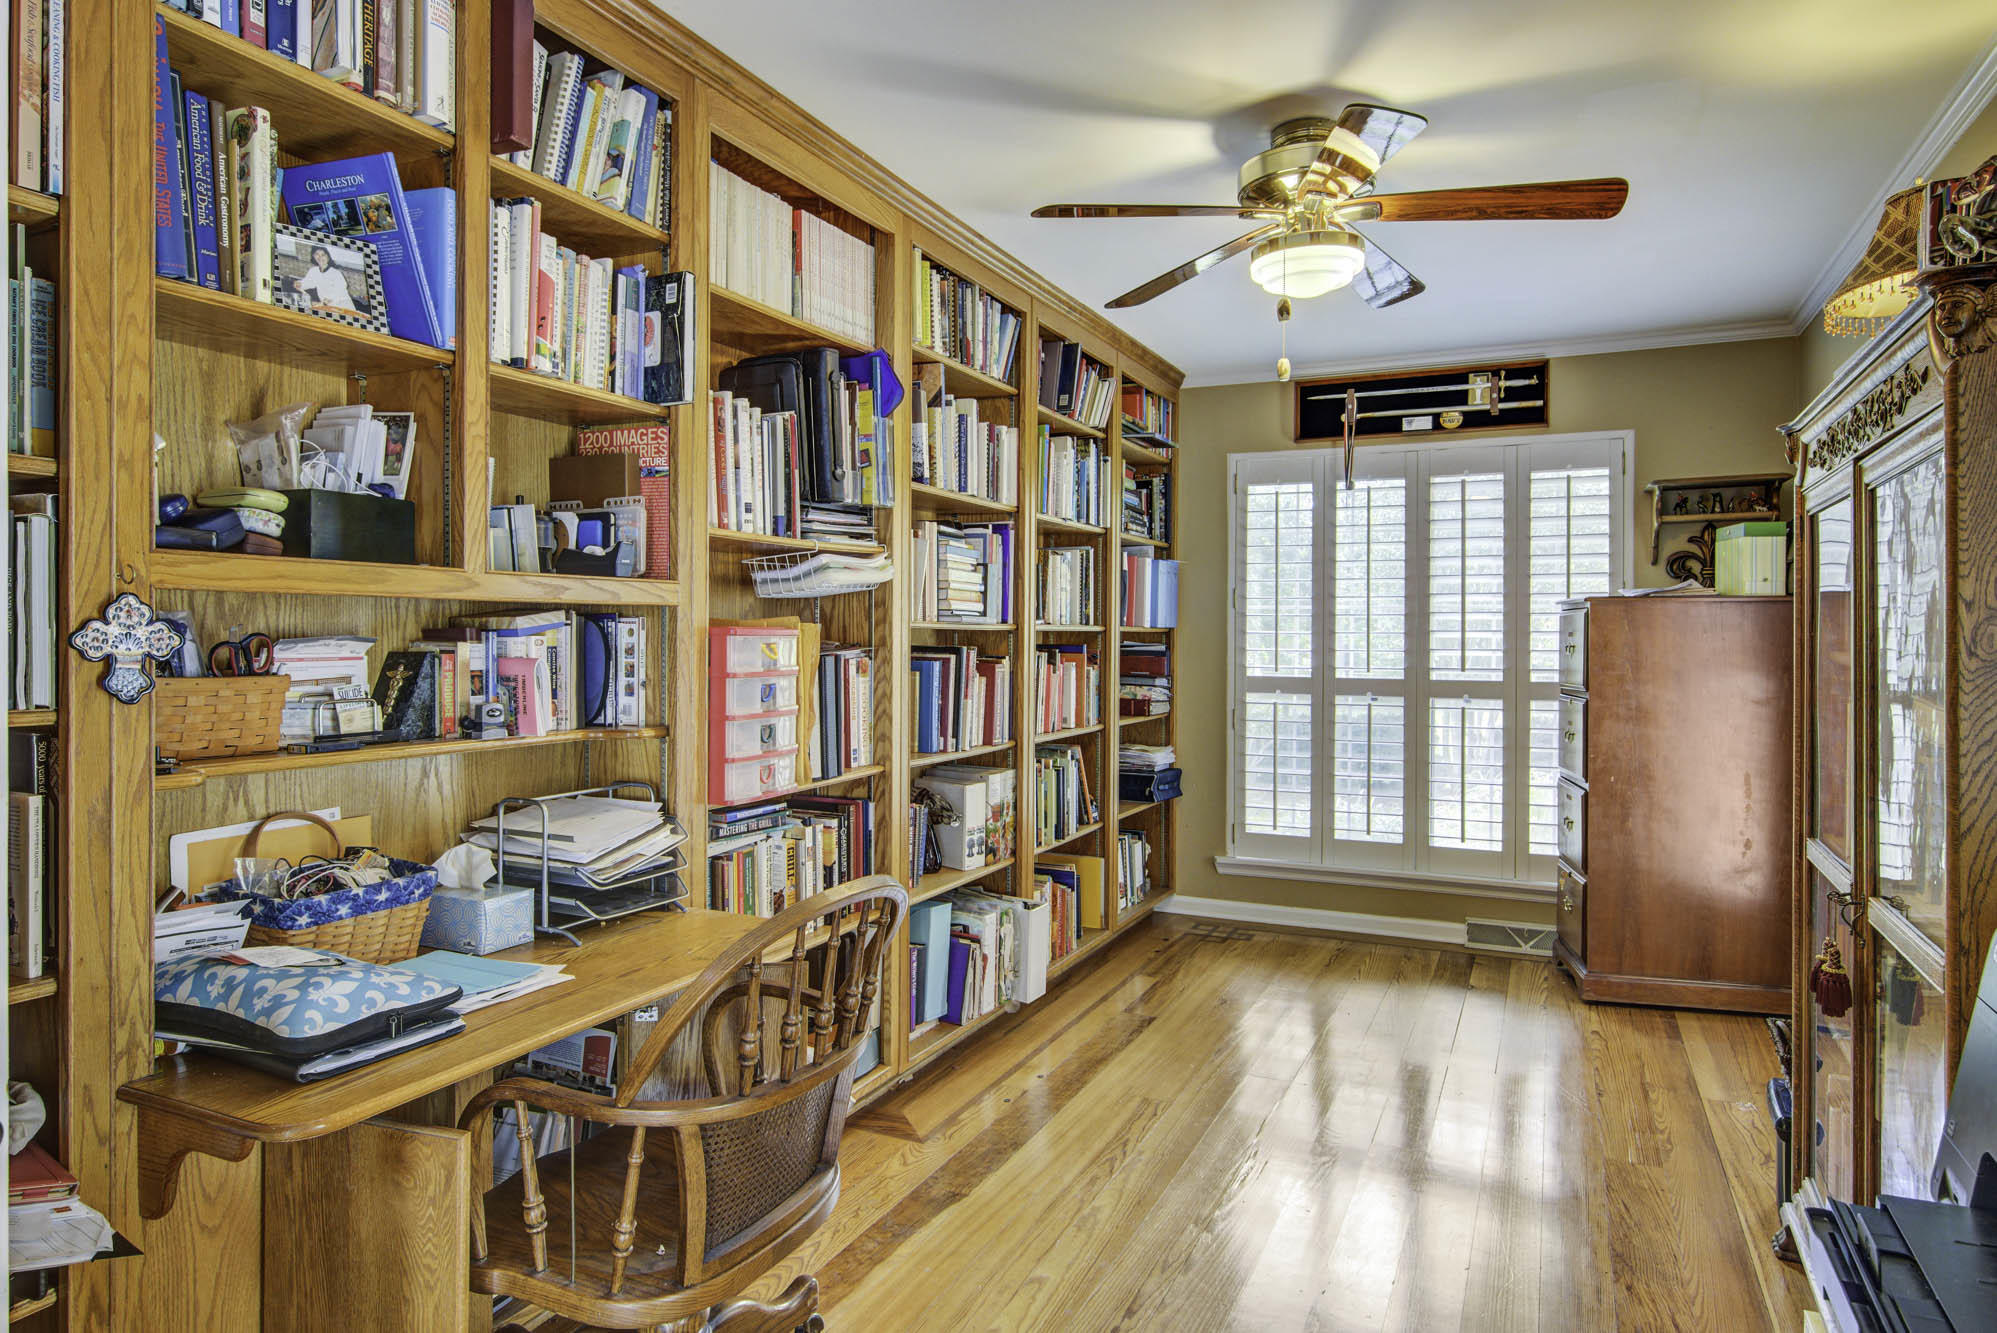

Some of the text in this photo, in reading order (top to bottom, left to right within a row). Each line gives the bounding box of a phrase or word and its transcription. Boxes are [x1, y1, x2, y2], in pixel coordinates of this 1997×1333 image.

[364, 3, 374, 67] HERITAGE
[52, 43, 61, 81] COOKING
[52, 82, 61, 103] FISH
[156, 145, 169, 184] UNITED
[190, 99, 210, 227] American Food & Drink
[218, 152, 228, 194] American
[305, 174, 366, 192] CHARLESTON
[156, 188, 172, 227] STATES
[220, 196, 230, 249] Gastronomy
[31, 299, 48, 389] ICE CREAM BOOK
[579, 427, 668, 449] 1200 IMAGES
[38, 741, 47, 762] 5000
[36, 765, 47, 785] years
[719, 818, 773, 837] MASTERING THE GRILL
